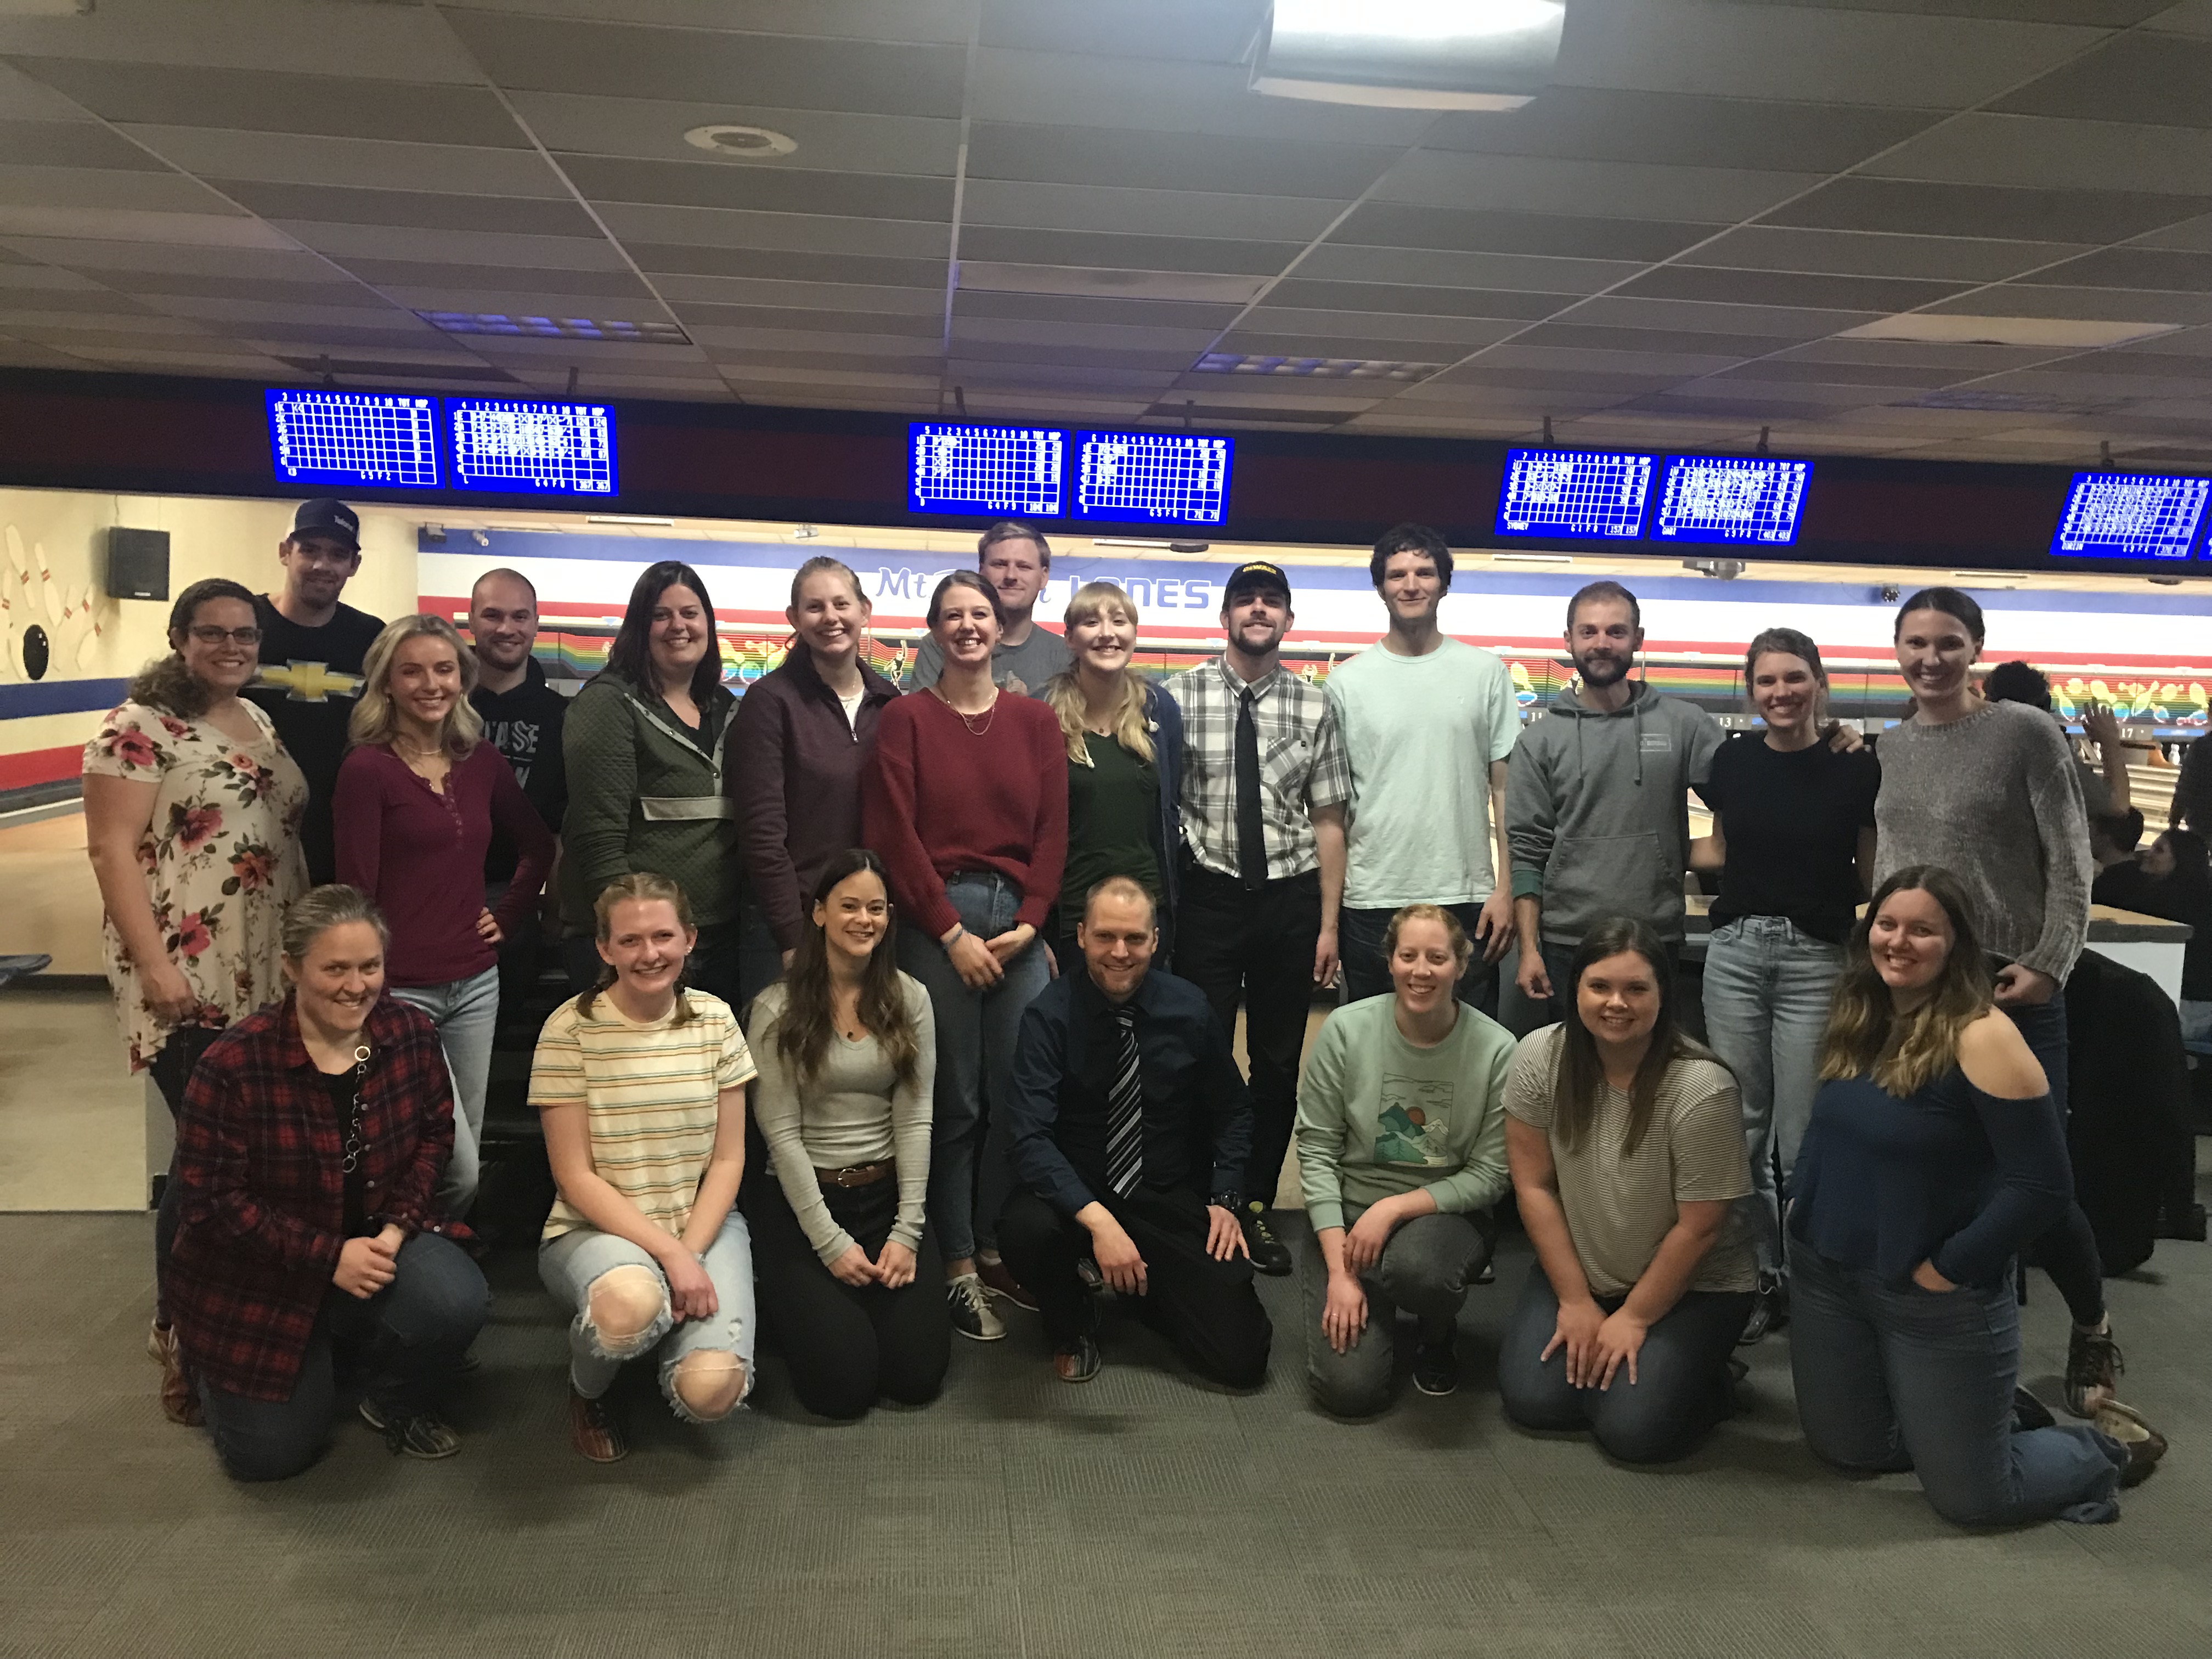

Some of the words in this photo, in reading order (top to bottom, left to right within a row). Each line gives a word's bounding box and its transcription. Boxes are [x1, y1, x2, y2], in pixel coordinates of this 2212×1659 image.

[297, 393, 301, 402] 1
[306, 393, 311, 403] 2
[316, 394, 320, 403] 3
[325, 394, 330, 403] 4
[335, 395, 340, 404] 5
[345, 396, 350, 404] 6
[355, 396, 359, 405] 7
[374, 397, 379, 406] 9
[385, 398, 393, 407] 10
[476, 402, 479, 410] 1
[485, 402, 489, 411] 2
[494, 403, 499, 411] 3
[514, 403, 518, 413] 5
[523, 404, 528, 413] 6
[533, 404, 537, 413] 7
[552, 405, 557, 414] 9
[562, 406, 570, 415] 10
[925, 426, 930, 435] 5
[939, 427, 941, 435] 1
[947, 427, 951, 436] 2
[956, 427, 961, 436] 3
[965, 428, 970, 436] 4
[974, 428, 979, 437] 5
[983, 428, 988, 437] 6
[992, 429, 997, 437] 7
[1011, 430, 1015, 438] 9
[1020, 431, 1028, 439] 10
[1092, 434, 1096, 442] 6
[1105, 435, 1108, 443] 1
[1113, 435, 1118, 443] 2
[1122, 435, 1127, 444] 3
[1140, 436, 1144, 444] 5
[1149, 437, 1154, 445] 6
[1176, 438, 1181, 446] 9
[1185, 438, 1193, 447] 10
[1523, 452, 1527, 460] 7
[1543, 453, 1548, 461] 2
[1552, 453, 1556, 461] 3
[1560, 454, 1565, 462] 4
[1569, 454, 1573, 462] 5
[1577, 454, 1582, 462] 6
[1603, 455, 1607, 464] 9
[1612, 456, 1620, 464] 10
[1700, 459, 1705, 467] 2
[1708, 459, 1713, 467] 3
[1725, 460, 1730, 469] 5
[1742, 461, 1747, 469] 7
[1759, 461, 1763, 470] 9
[1719, 717, 1731, 727] 13
[2121, 728, 2134, 738] 17
